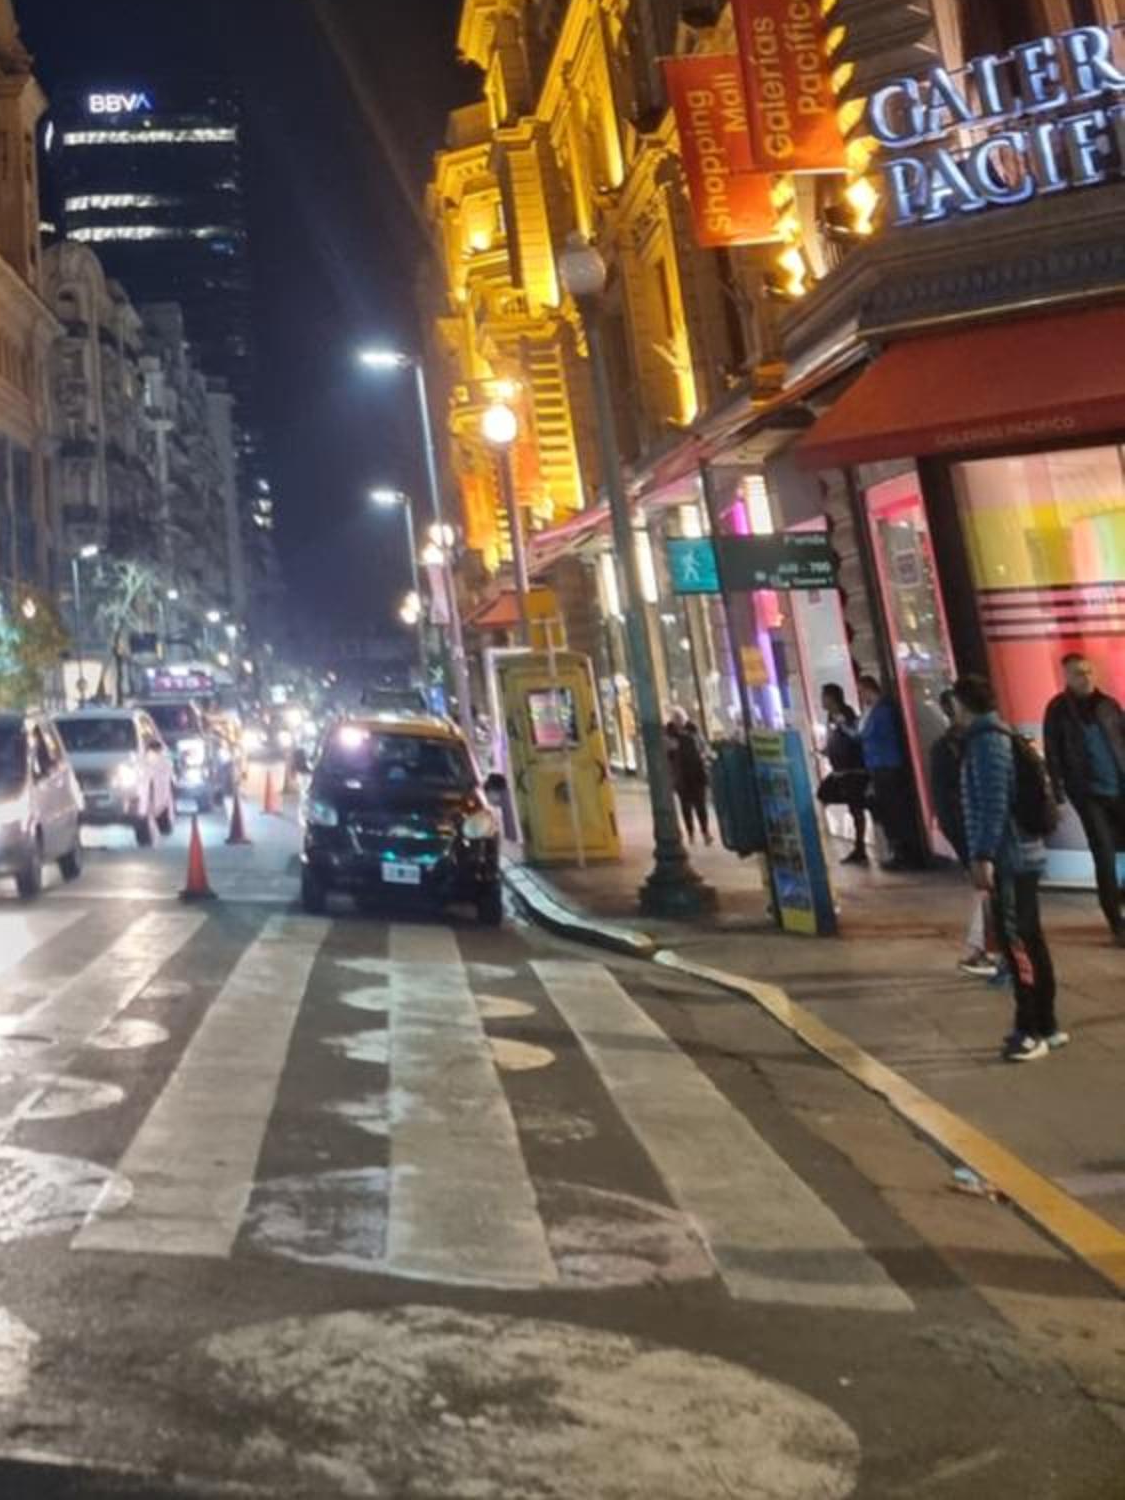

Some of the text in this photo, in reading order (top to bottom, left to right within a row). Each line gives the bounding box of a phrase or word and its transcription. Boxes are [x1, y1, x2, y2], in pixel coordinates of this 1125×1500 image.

[89, 92, 153, 114] BBVA
[714, 71, 748, 133] Mall
[749, 16, 794, 159] Galerías
[687, 88, 731, 233] Shopping
